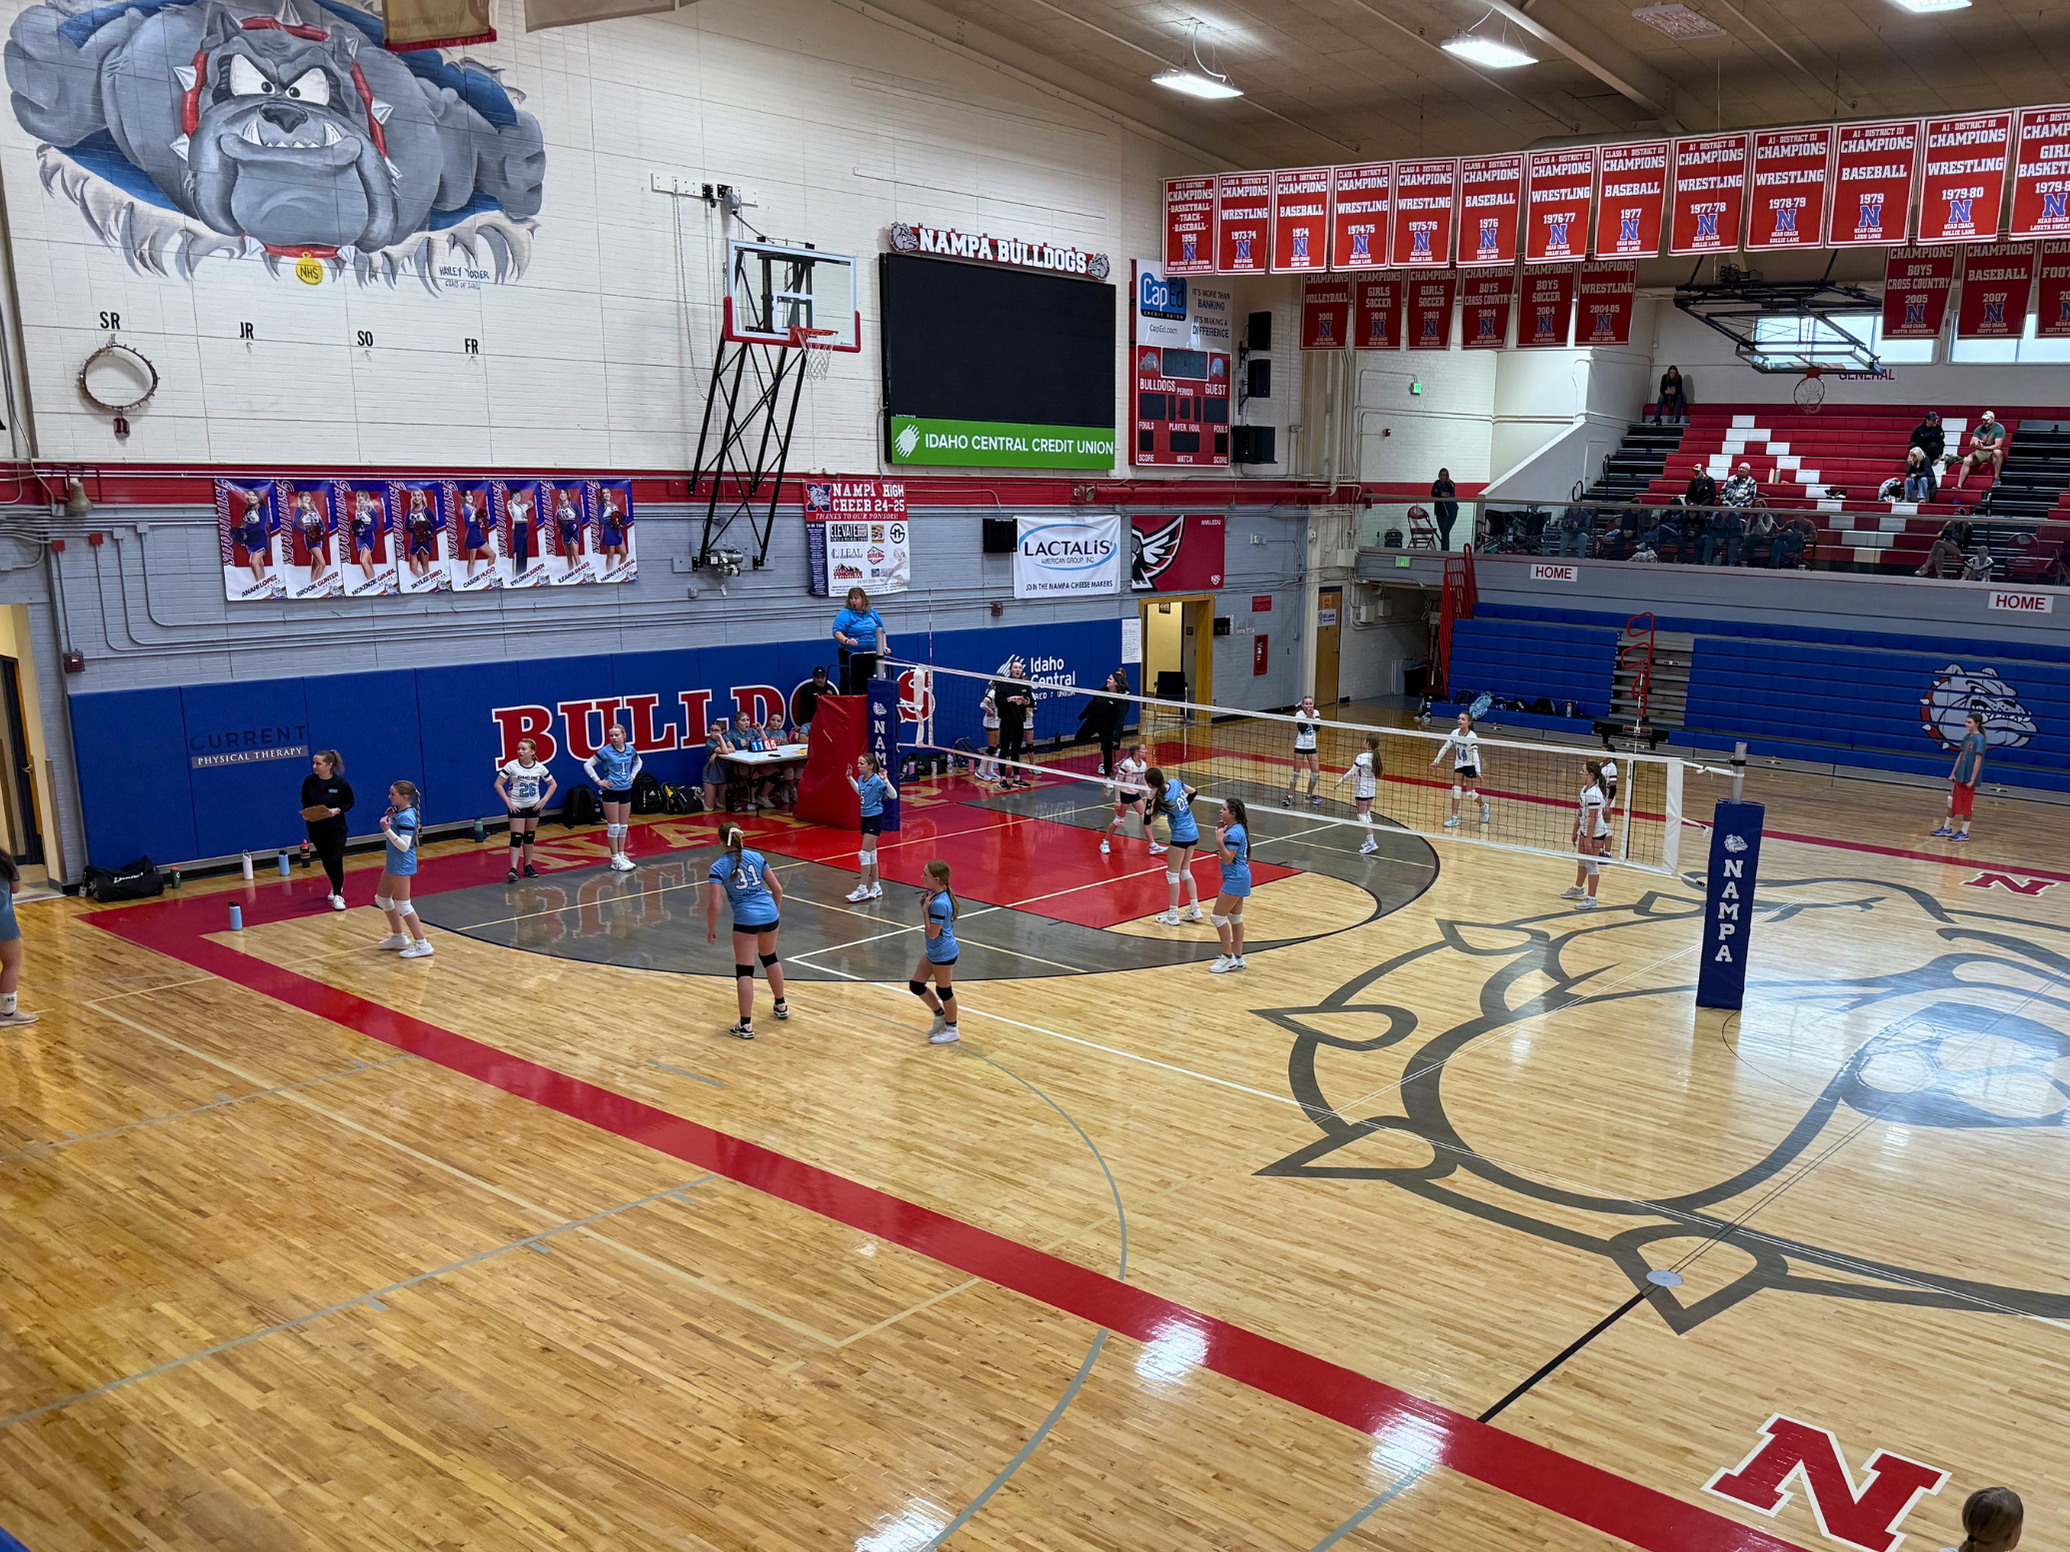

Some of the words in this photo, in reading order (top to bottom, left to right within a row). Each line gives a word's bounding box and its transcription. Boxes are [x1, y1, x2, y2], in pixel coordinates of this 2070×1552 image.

[1955, 121, 1986, 131] DISTRICT
[1988, 119, 1996, 127] III
[1865, 128, 1894, 137] DISTRICT
[1896, 127, 1904, 135] III
[1929, 129, 2006, 148] CHAMPIONS
[1757, 142, 1826, 160] CHAMPIONS
[1841, 136, 1914, 153] CHAMPIONS
[1604, 156, 1665, 172] CHAMPIONS
[1679, 149, 1744, 166] CHAMPIONS
[1532, 161, 1591, 178] CHAMPIONS
[1842, 165, 1907, 181] BASEBALL
[1928, 157, 2004, 176] WRESTLING
[1399, 173, 1452, 186] CHAMPIONS
[1464, 168, 1519, 183] CHAMPIONS
[1756, 169, 1825, 186] WRESTLING
[1278, 181, 1326, 194] CHAMPIONS
[1338, 177, 1388, 191] CHAMPIONS
[1605, 182, 1660, 197] BASEBALL
[1678, 175, 1742, 192] WRESTLING
[1168, 189, 1213, 201] CHAMPIONS
[1222, 185, 1268, 198] CHAMPIONS
[1532, 187, 1590, 203] WRESTLING
[1942, 187, 1984, 200] 1979-80
[1398, 197, 1451, 210] WRESTLING
[1465, 193, 1515, 207] BASEBALL
[1769, 197, 1806, 209] 1978-79
[1859, 193, 1884, 204] 1979
[2042, 193, 2067, 217] N
[1280, 204, 1324, 217] BASEBALL
[1337, 200, 1388, 214] WRESTLING
[1620, 208, 1642, 219] 1977
[1690, 202, 1726, 214] 1977-78
[1949, 200, 1973, 223] N
[1222, 208, 1268, 220] WRESTLING
[1543, 212, 1576, 224] 1976-77
[1776, 209, 1796, 231] N
[1859, 205, 1881, 227] N
[1347, 224, 1375, 235] 1974-75
[1408, 221, 1438, 231] 1975-76
[1479, 218, 1498, 229] 1976
[1620, 219, 1639, 240] N
[1697, 214, 1716, 236] N
[1182, 234, 1197, 243] 1956
[1231, 230, 1257, 240] 1973-74
[1292, 228, 1309, 237] 1974
[1480, 229, 1497, 249] N
[1550, 224, 1568, 244] N
[1293, 237, 1307, 257] N
[1353, 235, 1368, 254] N
[1414, 231, 1430, 251] N
[918, 227, 994, 262] NAMPA
[997, 238, 1087, 274] BULLDOGS
[1183, 243, 1196, 261] N
[1237, 240, 1250, 258] N
[1890, 246, 1954, 260] CHAMPIONS
[1967, 242, 2033, 257] CHAMPIONS
[300, 265, 319, 280] NHS
[1465, 266, 1513, 279] CHAMPIONS
[1523, 263, 1573, 276] CHAMPIONS
[1583, 260, 1634, 272] CHAMPIONS
[1907, 264, 1932, 277] BOYS
[464, 268, 490, 279] YODER
[1306, 273, 1349, 284] CHAMPIONS
[1357, 271, 1401, 282] CHAMPIONS
[1410, 270, 1456, 281] CHAMPIONS
[1968, 268, 2027, 282] BASEBALL
[1421, 285, 1444, 295] GIRLS
[1479, 283, 1498, 293] BOYS
[1536, 280, 1558, 291] BOYS
[1581, 282, 1633, 294] WRESTLING
[1887, 278, 1911, 291] CROSS
[1913, 277, 1950, 289] COUNTRY
[1143, 278, 1184, 311] CapEd
[1192, 288, 1201, 296] IT'S
[1202, 289, 1217, 298] MORE
[1218, 292, 1231, 300] THAN
[1306, 293, 1348, 303] VOLLEYBALL
[1367, 287, 1390, 297] GIRLS
[1532, 292, 1561, 303] SOCCER
[1982, 292, 2008, 303] 2007
[1198, 299, 1225, 311] BANKING
[1366, 298, 1391, 308] SOCCER
[1418, 297, 1445, 307] SOCCER
[1464, 295, 1482, 306] CROSS
[1905, 294, 1928, 304] 2005
[1423, 311, 1439, 319] 2001
[1478, 309, 1496, 317] 2004
[1536, 307, 1555, 315] 2004
[1589, 304, 1620, 313] 2004-05
[99, 311, 121, 330] SR
[1204, 317, 1223, 325] MAKING
[1318, 313, 1333, 321] 2001
[1371, 312, 1387, 320] 2001
[239, 322, 255, 340] JR
[1149, 324, 1178, 334] CapEd.com
[1192, 326, 1229, 338] DIFFERENCE
[357, 330, 374, 347] SO
[464, 338, 479, 355] FR
[1140, 379, 1176, 392] BULLDOGS
[1177, 388, 1193, 396] PERIOD
[1205, 383, 1226, 395] GUEST
[1139, 421, 1154, 430] FOULS
[1169, 423, 1186, 431] PLAYER
[1189, 424, 1200, 432] FOUL
[1214, 425, 1228, 433] FOULS
[925, 433, 968, 450] IDAHO
[972, 435, 1029, 452] CENTRAL
[1032, 437, 1074, 454] CREDIT
[1077, 439, 1114, 455] UNION
[1139, 454, 1154, 462] SCORE
[1177, 455, 1193, 463] MATCH
[1214, 456, 1228, 464] SCORE
[832, 483, 876, 497] NAMPA
[883, 484, 904, 497] HIGH
[833, 499, 871, 512] CHEER
[874, 499, 905, 512] 24-25
[1535, 566, 1573, 580] HOME
[1049, 582, 1070, 590] NAMPA
[1071, 581, 1090, 589] CHEESE
[1995, 594, 2047, 611] HOME
[1031, 656, 1064, 673] Idaho
[1031, 670, 1075, 689] Central
[491, 669, 936, 772] BULLDOS
[189, 725, 306, 750] CURRENT
[874, 720, 887, 766] NAM
[198, 753, 250, 766] PHYSICAL
[254, 747, 302, 760] THERAPY
[620, 761, 627, 776] 1
[519, 782, 537, 798] 26
[488, 777, 1058, 870] NAPA
[732, 865, 761, 890] 31
[1960, 872, 2060, 898] N
[1714, 858, 1744, 964] NAMPA
[1700, 1412, 1953, 1552] N
